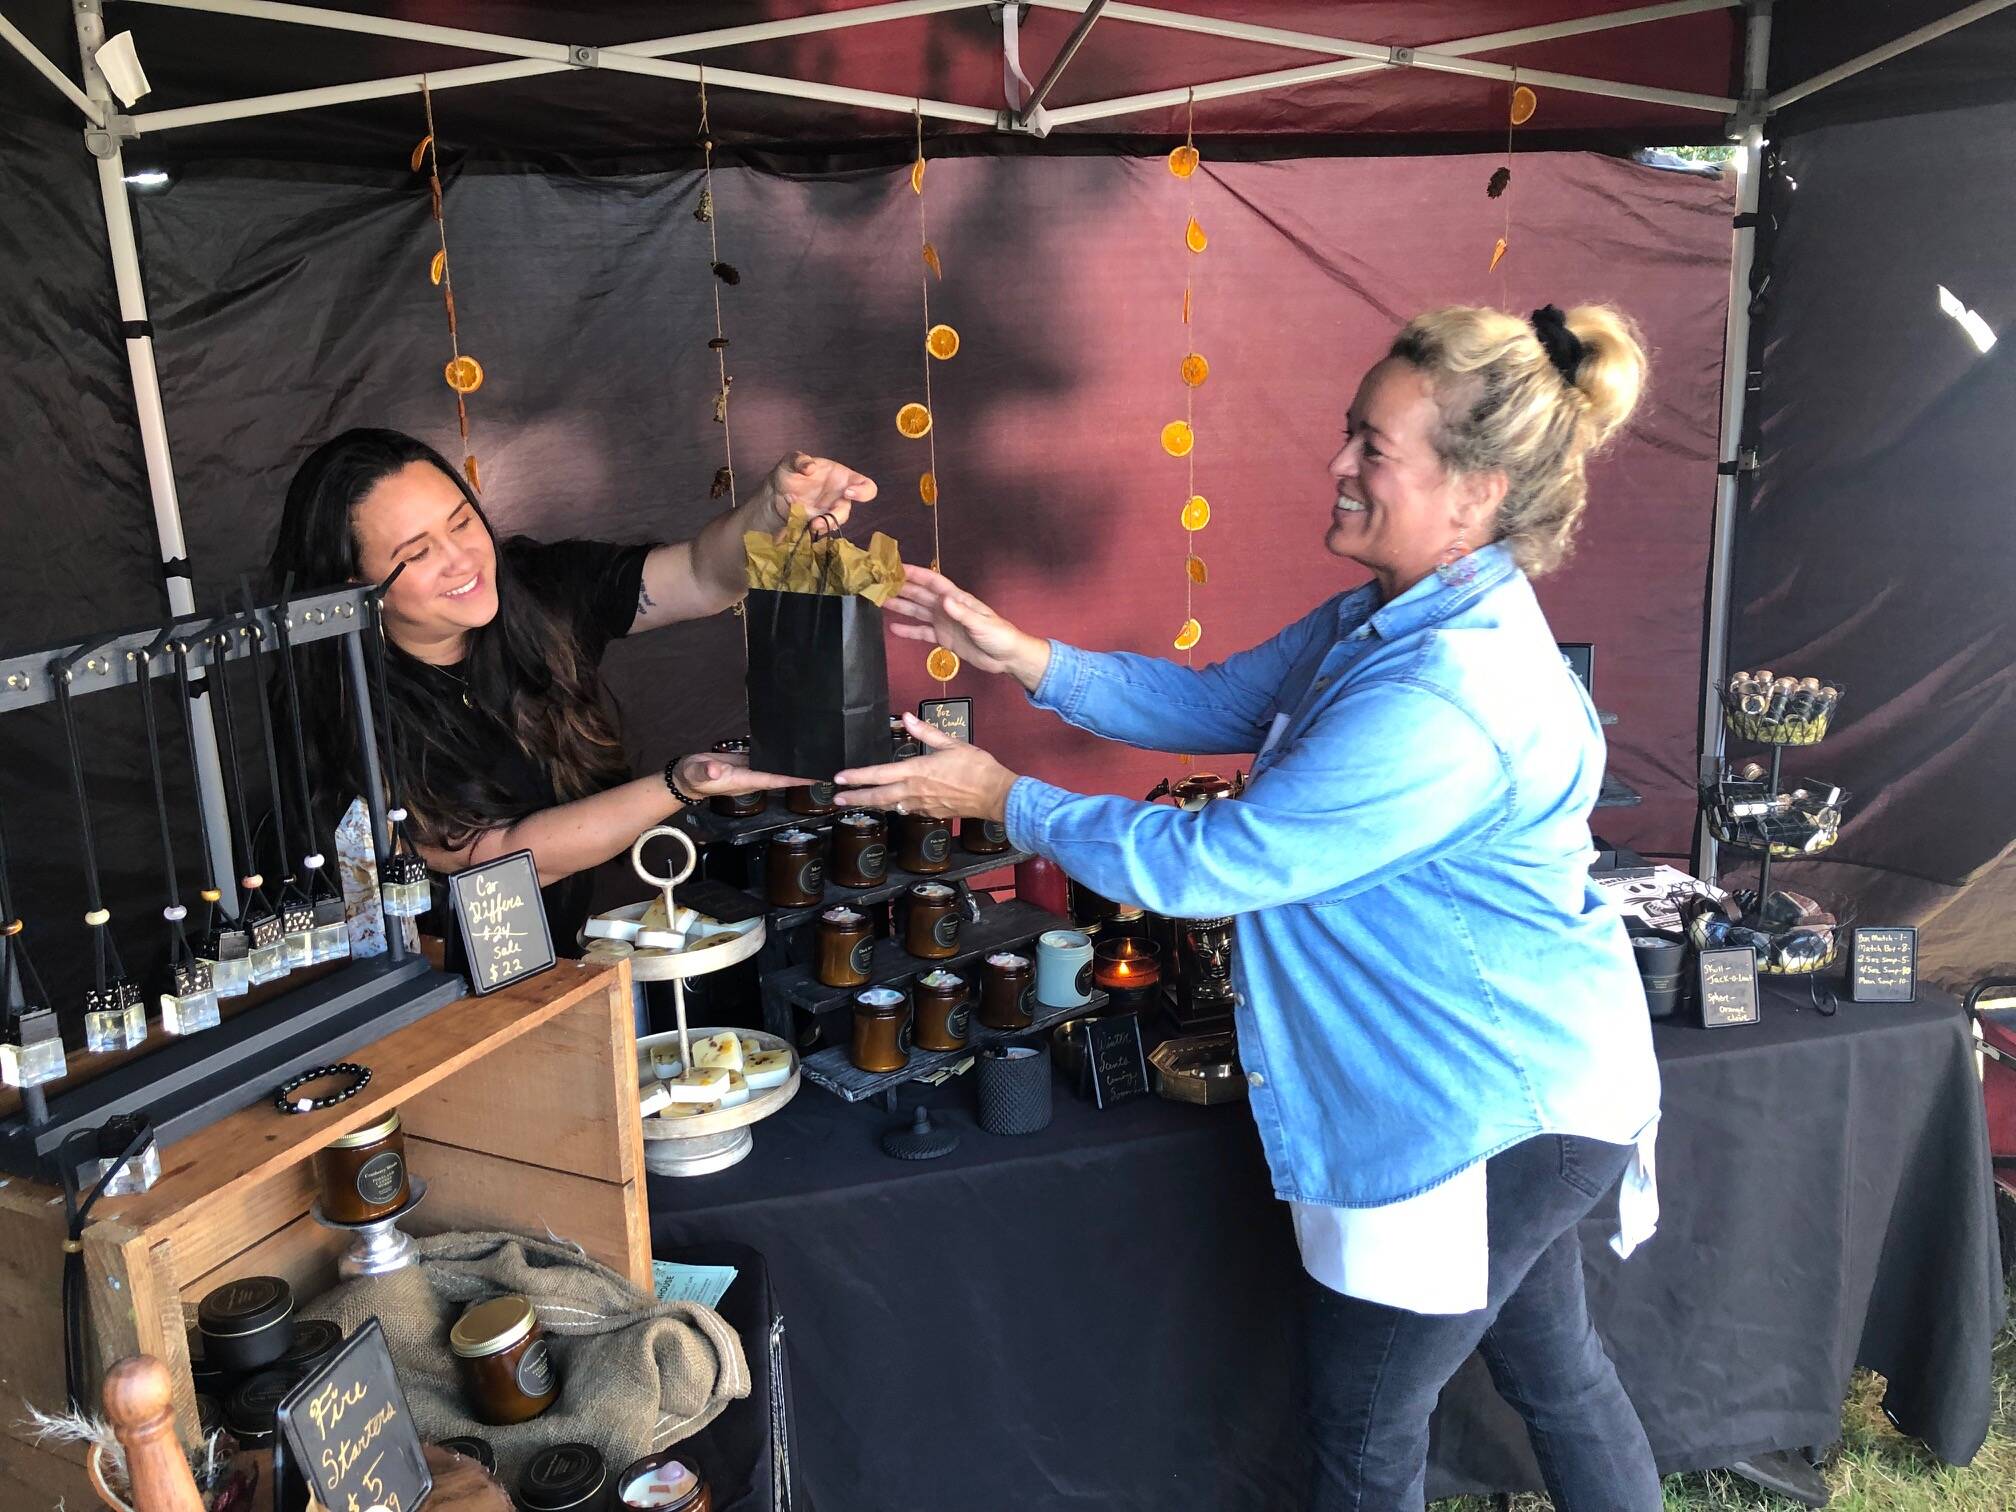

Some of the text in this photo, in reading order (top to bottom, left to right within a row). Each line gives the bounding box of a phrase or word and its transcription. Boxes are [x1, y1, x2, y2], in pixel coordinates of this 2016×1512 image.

[942, 715, 966, 728] Candle
[476, 875, 499, 896] Car
[310, 1381, 367, 1441] Fire
[322, 1401, 397, 1490] Starters
